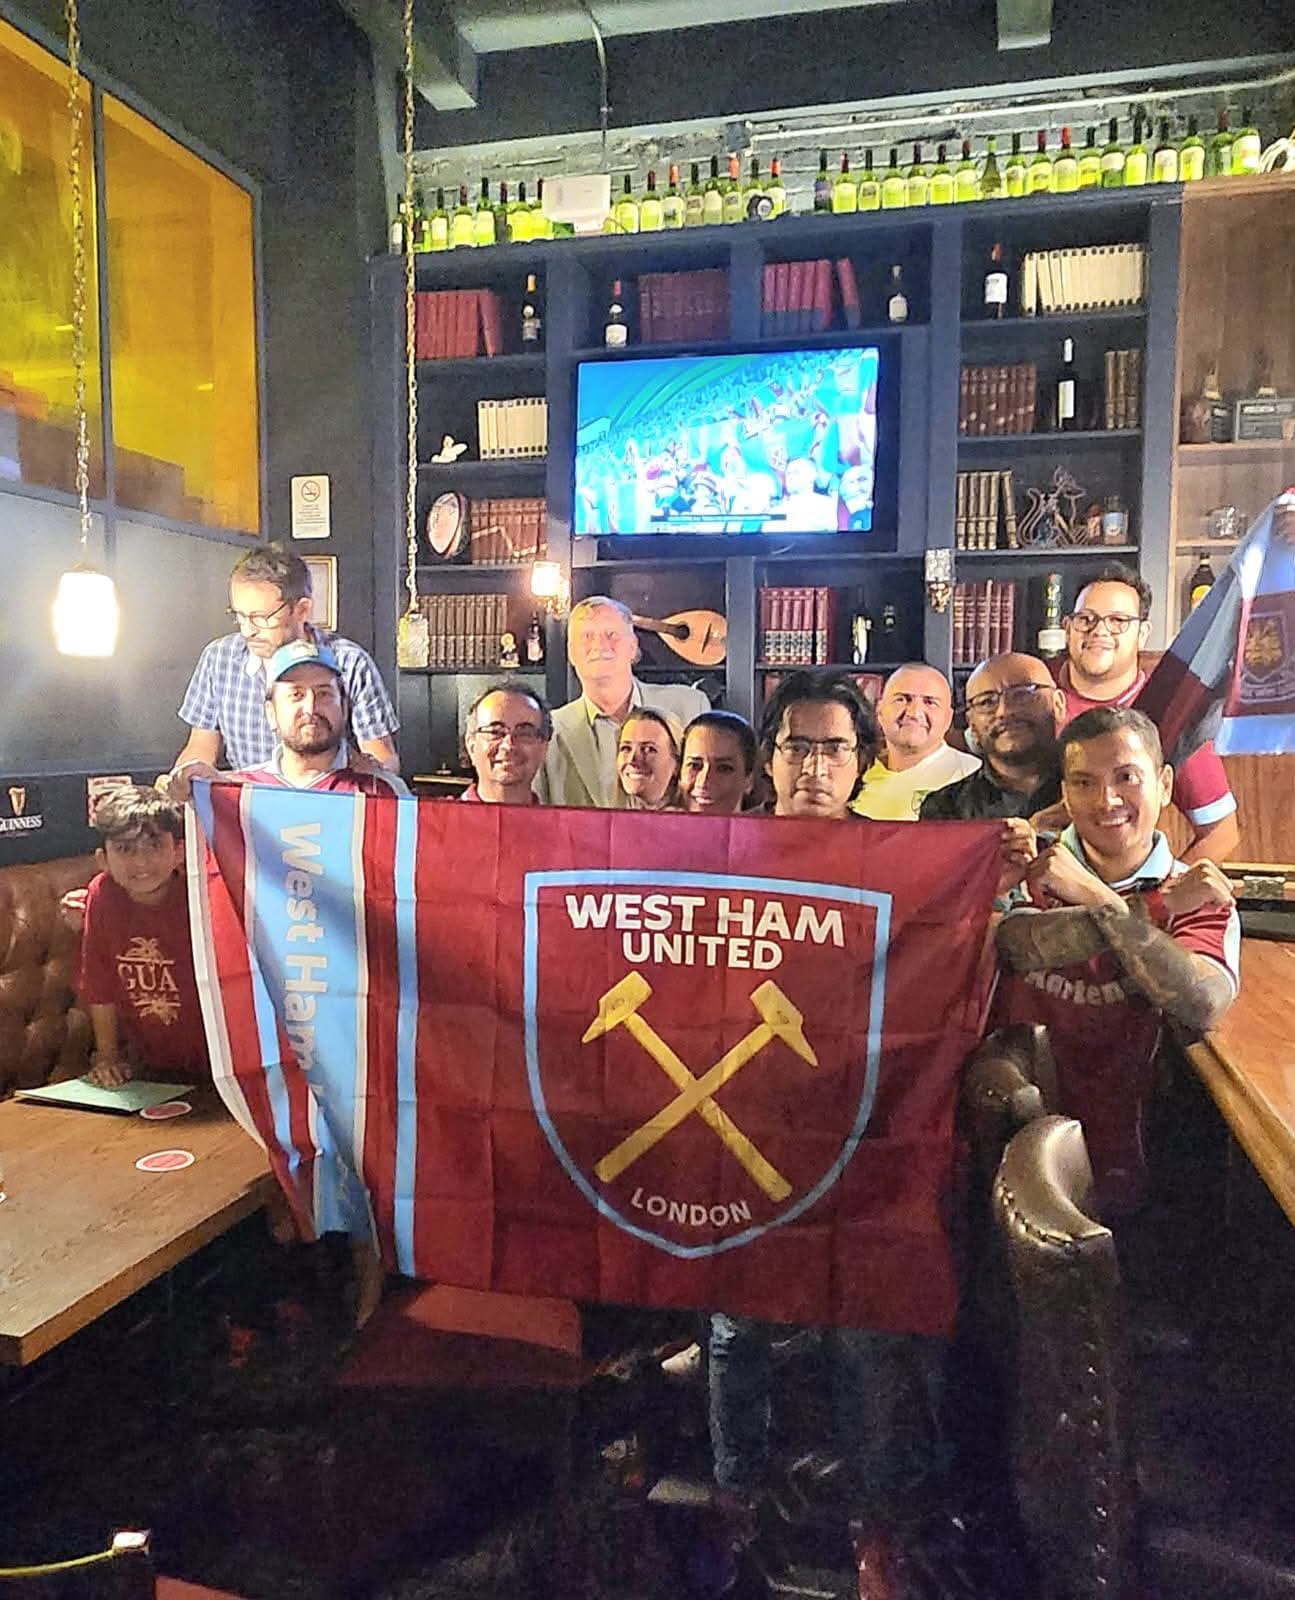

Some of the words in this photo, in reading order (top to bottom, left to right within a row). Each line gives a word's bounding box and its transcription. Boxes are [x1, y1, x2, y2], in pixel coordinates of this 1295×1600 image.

[280, 822, 325, 943] West
[565, 893, 706, 932] WEST
[717, 897, 846, 949] HAM
[622, 932, 784, 971] UNITED
[117, 963, 178, 992] GUA
[284, 954, 327, 1071] Ham
[631, 1187, 753, 1228] LONDON
